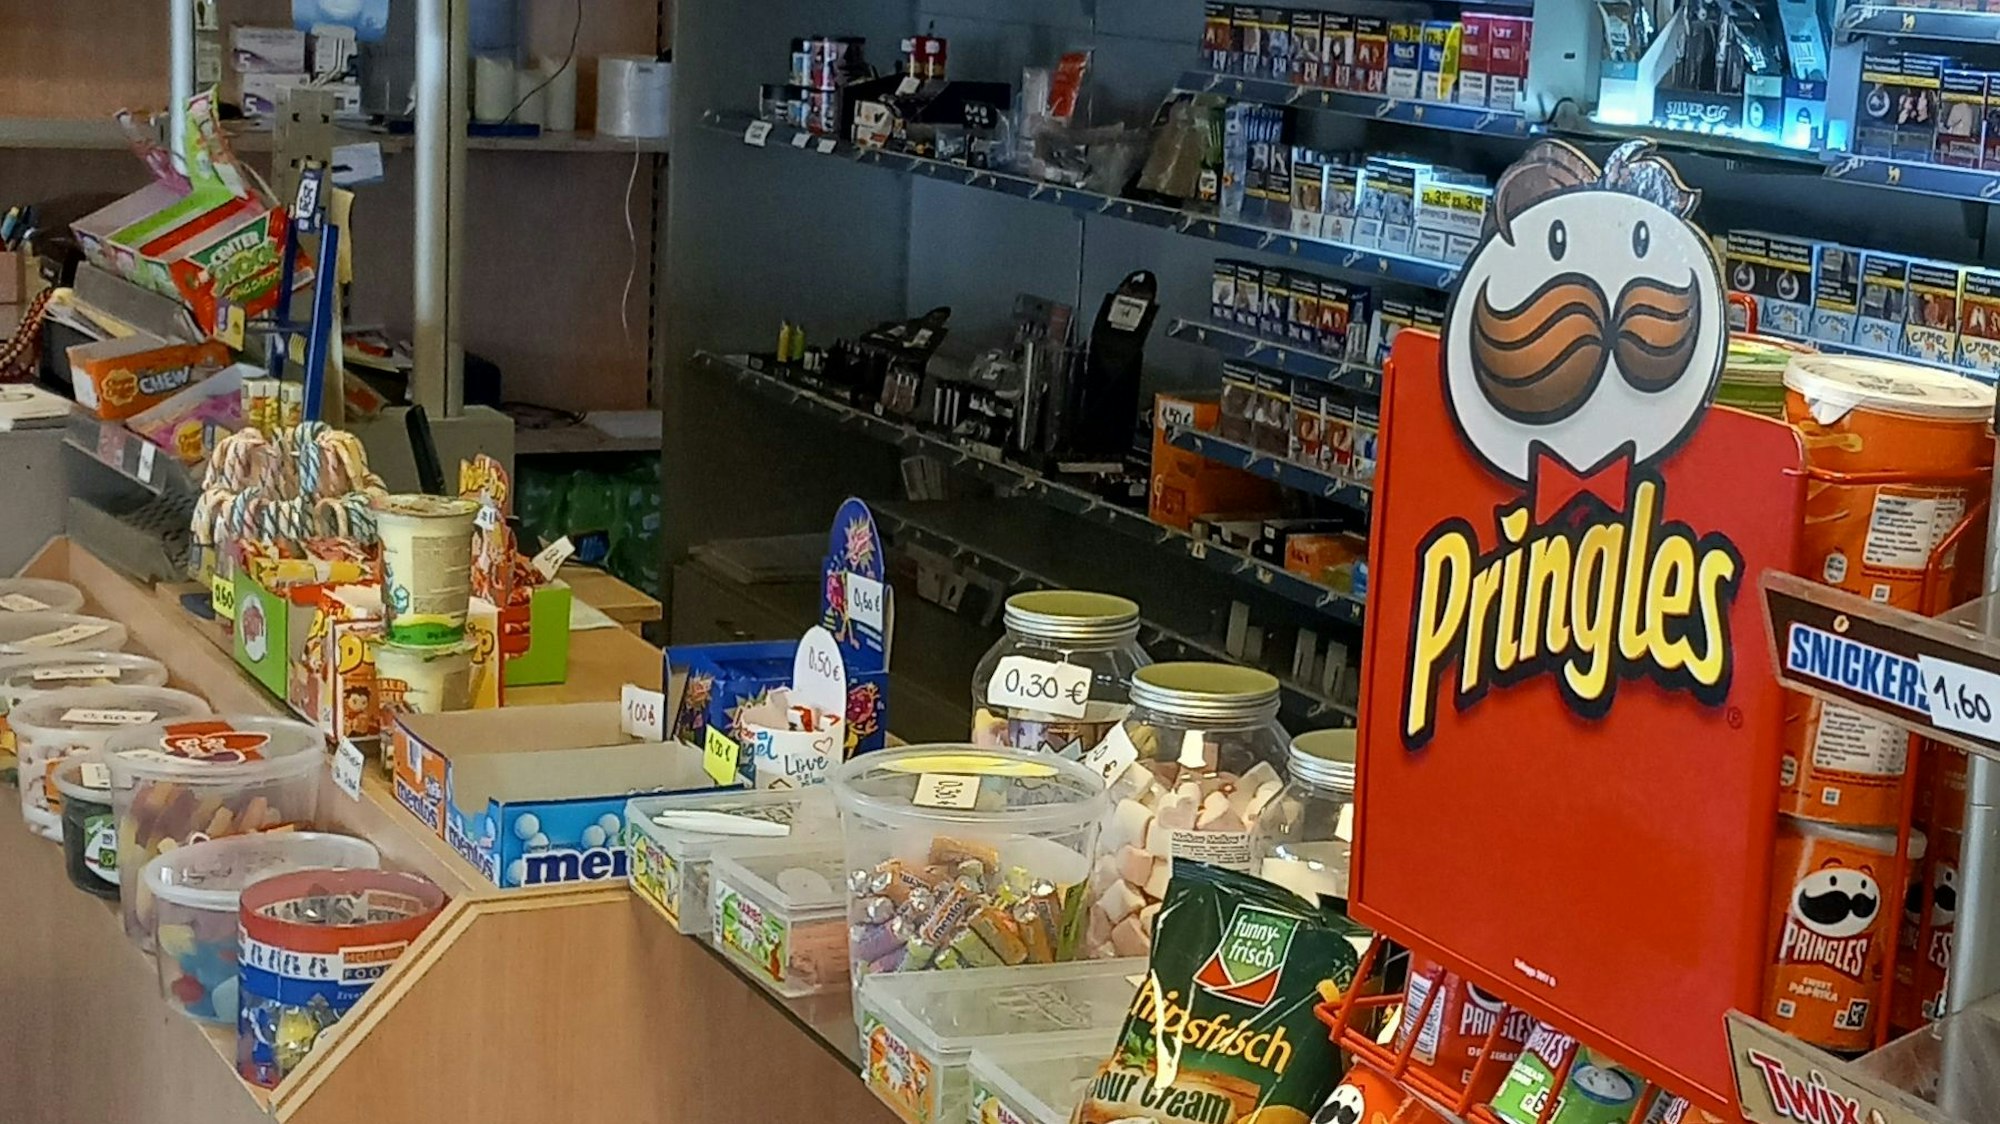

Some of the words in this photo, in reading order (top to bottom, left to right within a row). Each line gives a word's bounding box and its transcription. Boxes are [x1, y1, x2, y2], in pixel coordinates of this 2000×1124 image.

[1665, 102, 1702, 119] SILVER
[1911, 330, 1948, 349] CAMEL
[140, 365, 190, 394] CHEW
[1407, 480, 1735, 735] Pringles
[1934, 675, 1992, 723] 1,60
[397, 779, 438, 830] mentos
[449, 825, 494, 882] mentos
[1234, 914, 1280, 943] funny-
[1778, 919, 1868, 977] PRINGLES
[1228, 940, 1275, 968] frisch
[1788, 982, 1838, 1003] PAPRIKA
[1131, 979, 1292, 1075] hipsfrisch
[1140, 1076, 1233, 1124] Cream
